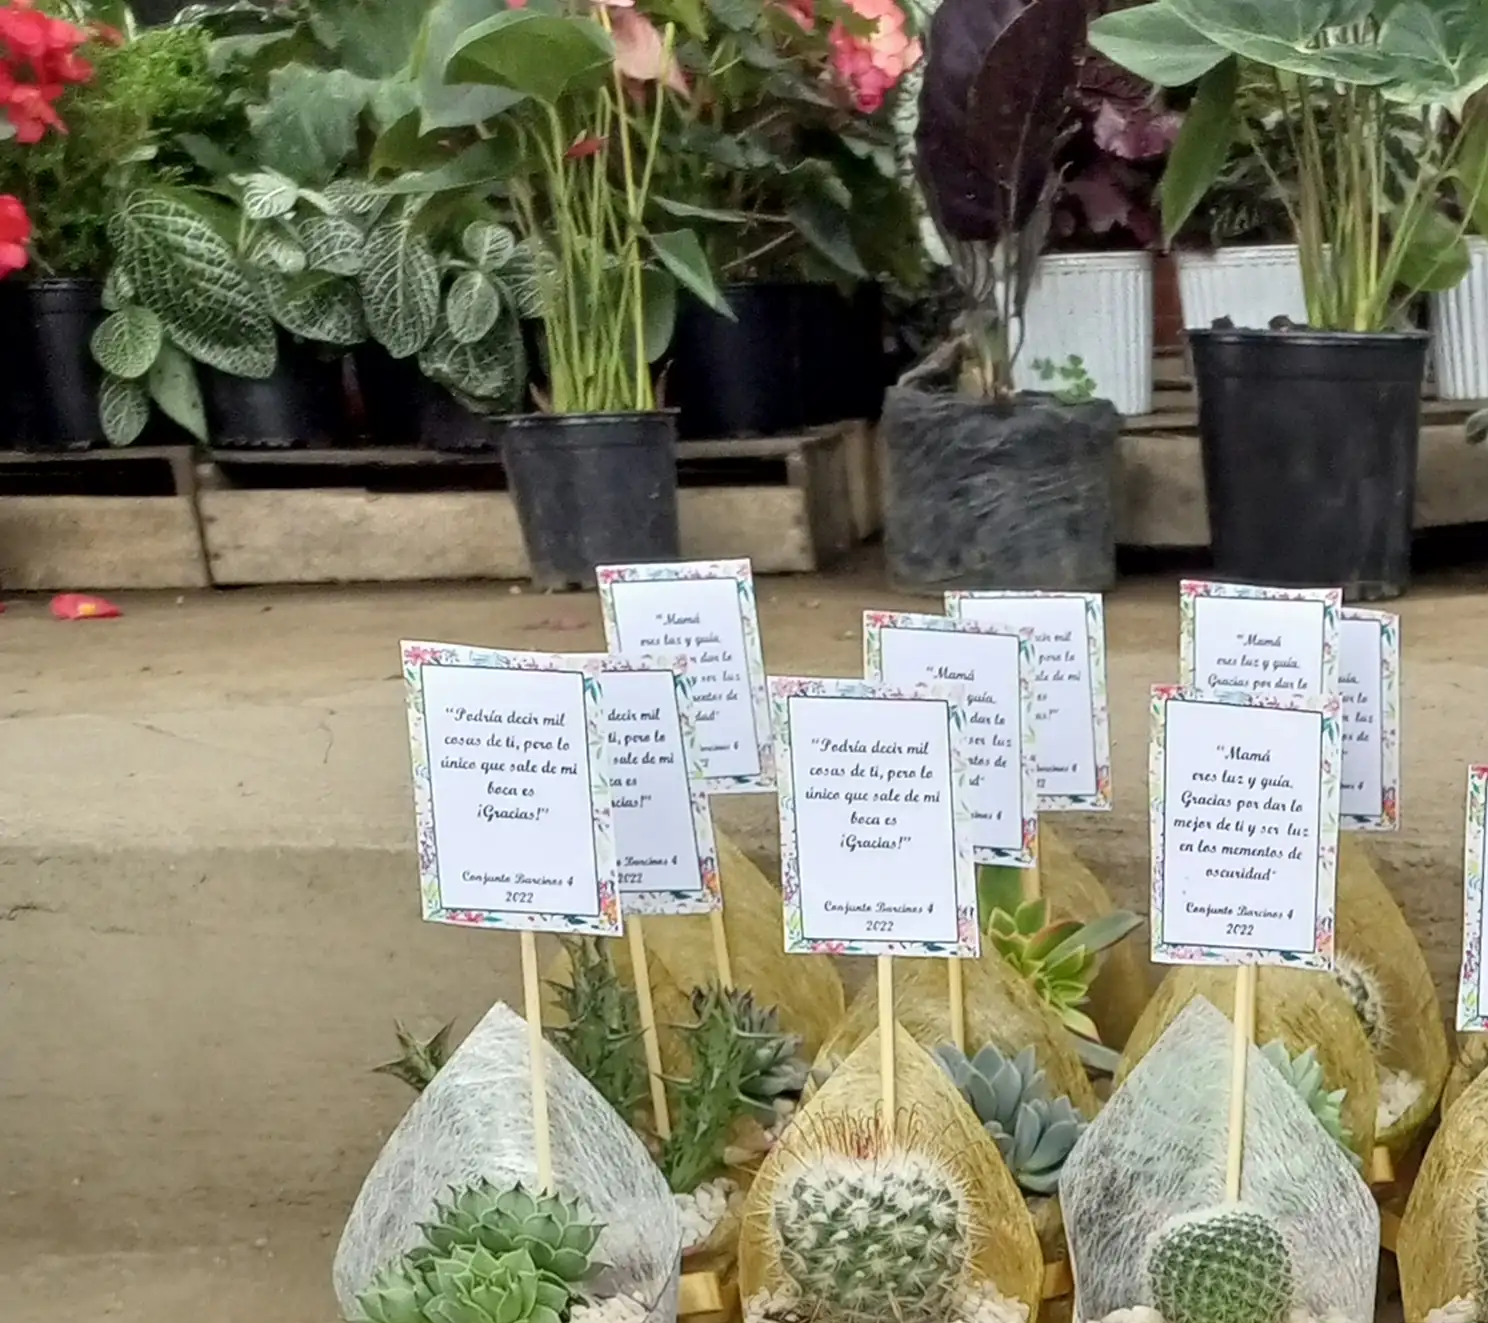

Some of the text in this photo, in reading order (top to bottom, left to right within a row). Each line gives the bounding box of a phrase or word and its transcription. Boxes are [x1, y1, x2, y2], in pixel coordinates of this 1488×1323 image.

[506, 710, 539, 725] decir
[542, 712, 565, 727] mil
[443, 733, 570, 753] cosas de ti, pero lo
[440, 755, 578, 775] único que sale de mi
[486, 780, 535, 797] boca es
[461, 870, 574, 887] Conjunto Barcinos 4
